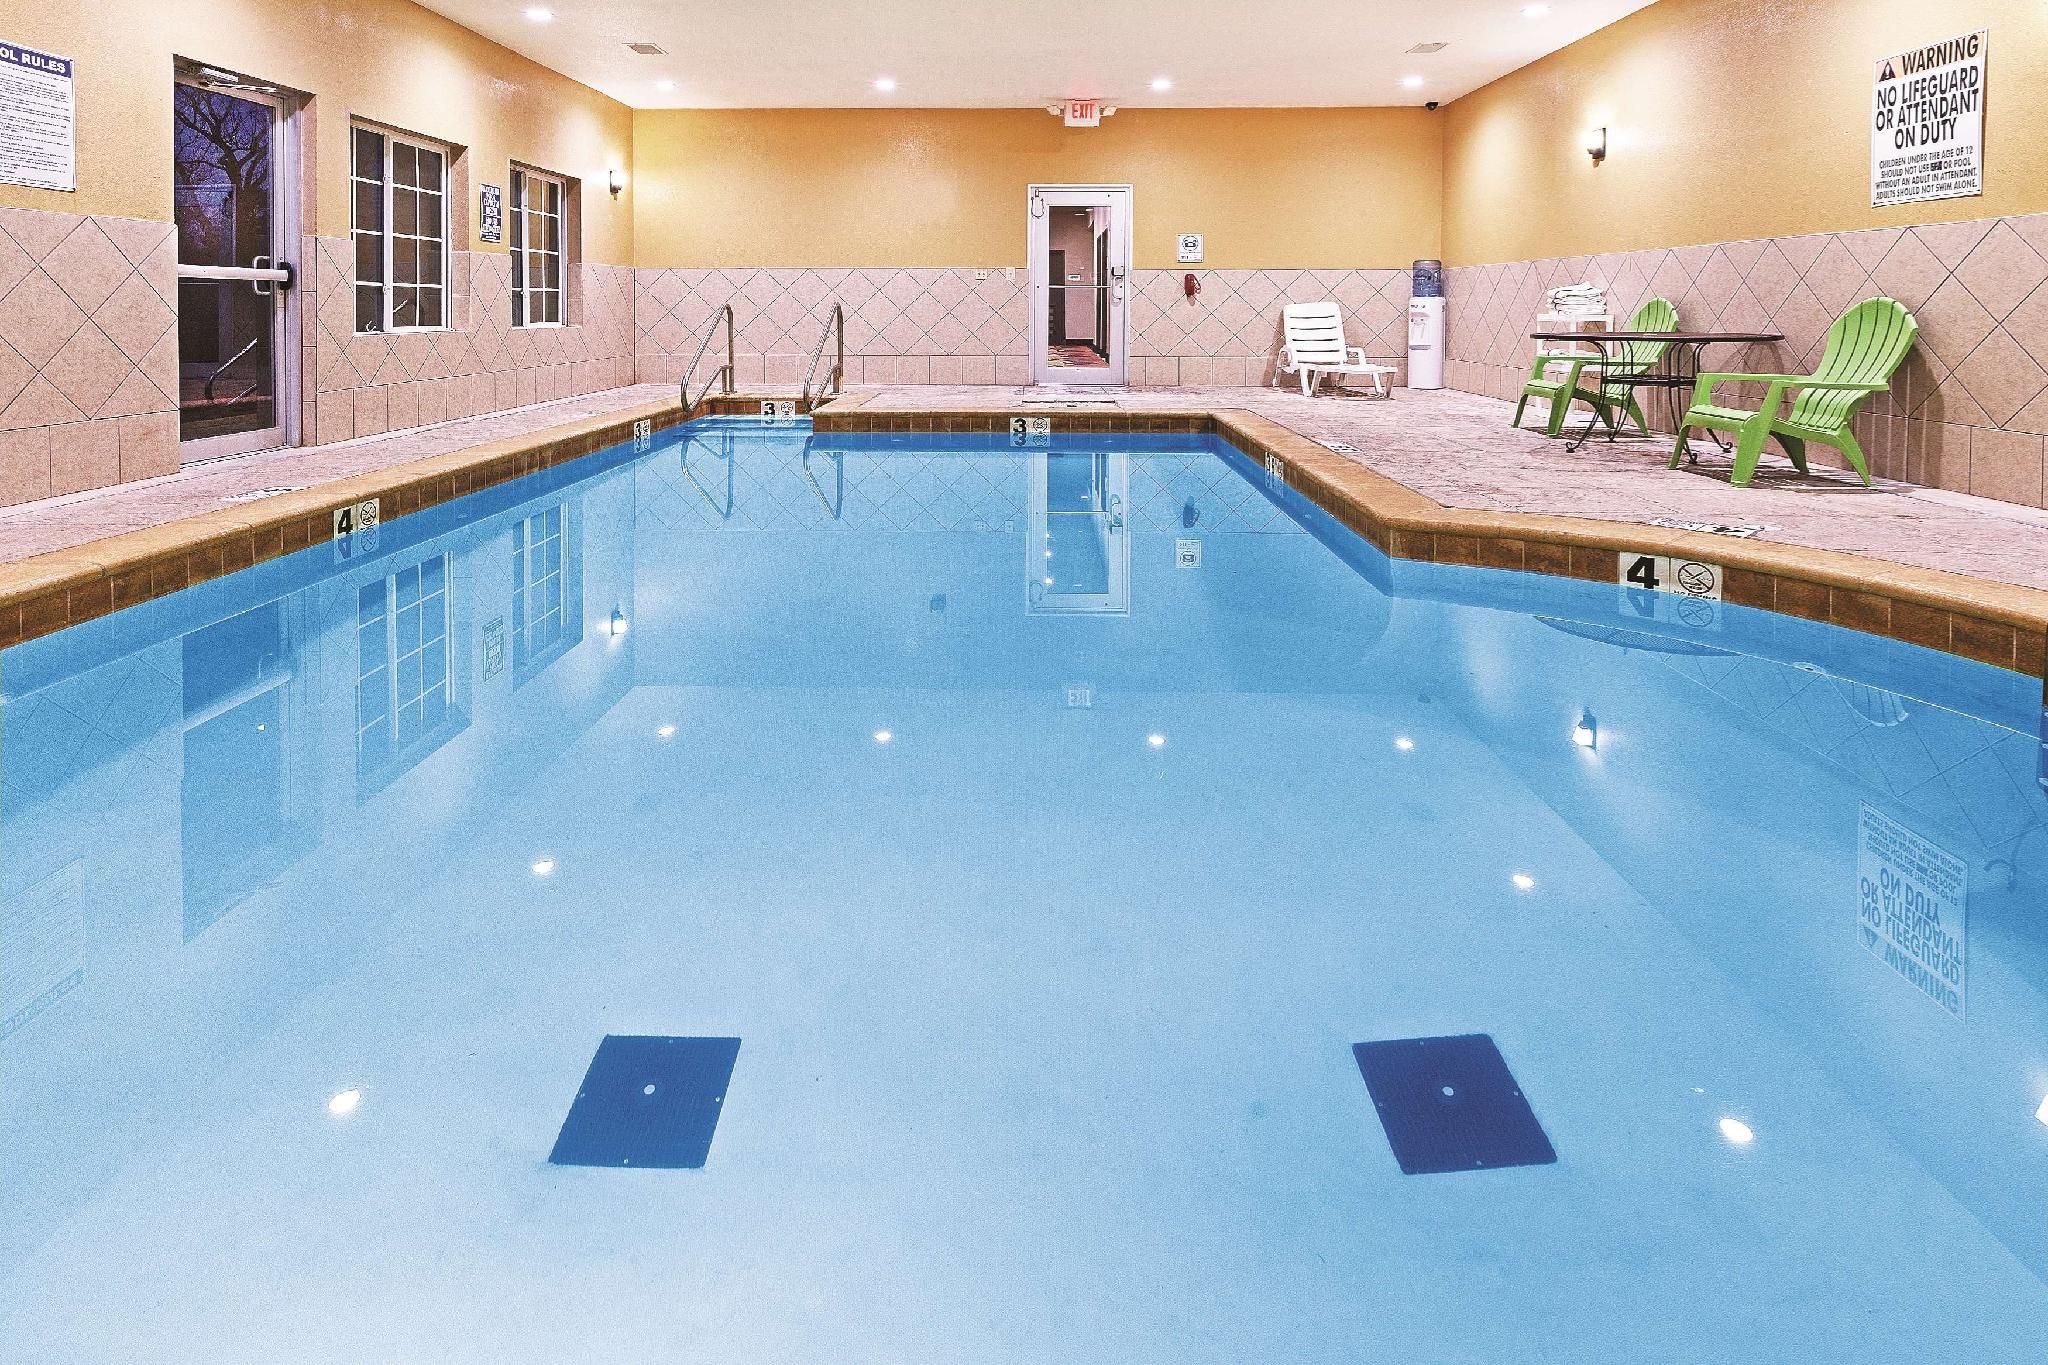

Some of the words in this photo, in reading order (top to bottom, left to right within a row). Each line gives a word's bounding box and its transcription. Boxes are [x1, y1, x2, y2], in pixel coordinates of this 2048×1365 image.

[21, 53, 66, 74] RULES
[1902, 35, 1978, 75] WARNING
[1877, 86, 1897, 109] NO
[1902, 66, 1978, 104] LIFEGUARD
[1072, 104, 1095, 119] EXIT
[1876, 109, 1893, 131] OR
[1898, 88, 1979, 127] ATTENDANT
[1895, 126, 1915, 149] ON
[1920, 117, 1957, 145] DUTY
[1879, 157, 1906, 169] CHILDREN
[1907, 153, 1928, 164] UNDER
[1929, 151, 1940, 160] THE
[1941, 149, 1954, 158] AGE
[1955, 147, 1964, 156] OF
[1881, 168, 1903, 178] SHOULD
[1904, 166, 1917, 175] NOT
[1918, 163, 1930, 173] USE
[1943, 160, 1952, 169] OR
[1954, 157, 1971, 167] POOL
[1875, 178, 1900, 190] WITHOUT
[1901, 176, 1910, 185] AN
[1911, 173, 1930, 184] ADULT
[1931, 172, 1939, 181] IN
[1875, 190, 1896, 200] ADULTS
[1897, 187, 1920, 197] SHOULD
[1921, 185, 1934, 194] NOT
[1936, 182, 1952, 192] SWIM
[764, 403, 775, 415] 3
[1013, 418, 1027, 433] 3
[337, 507, 353, 535] 4
[1627, 556, 1660, 589] 4
